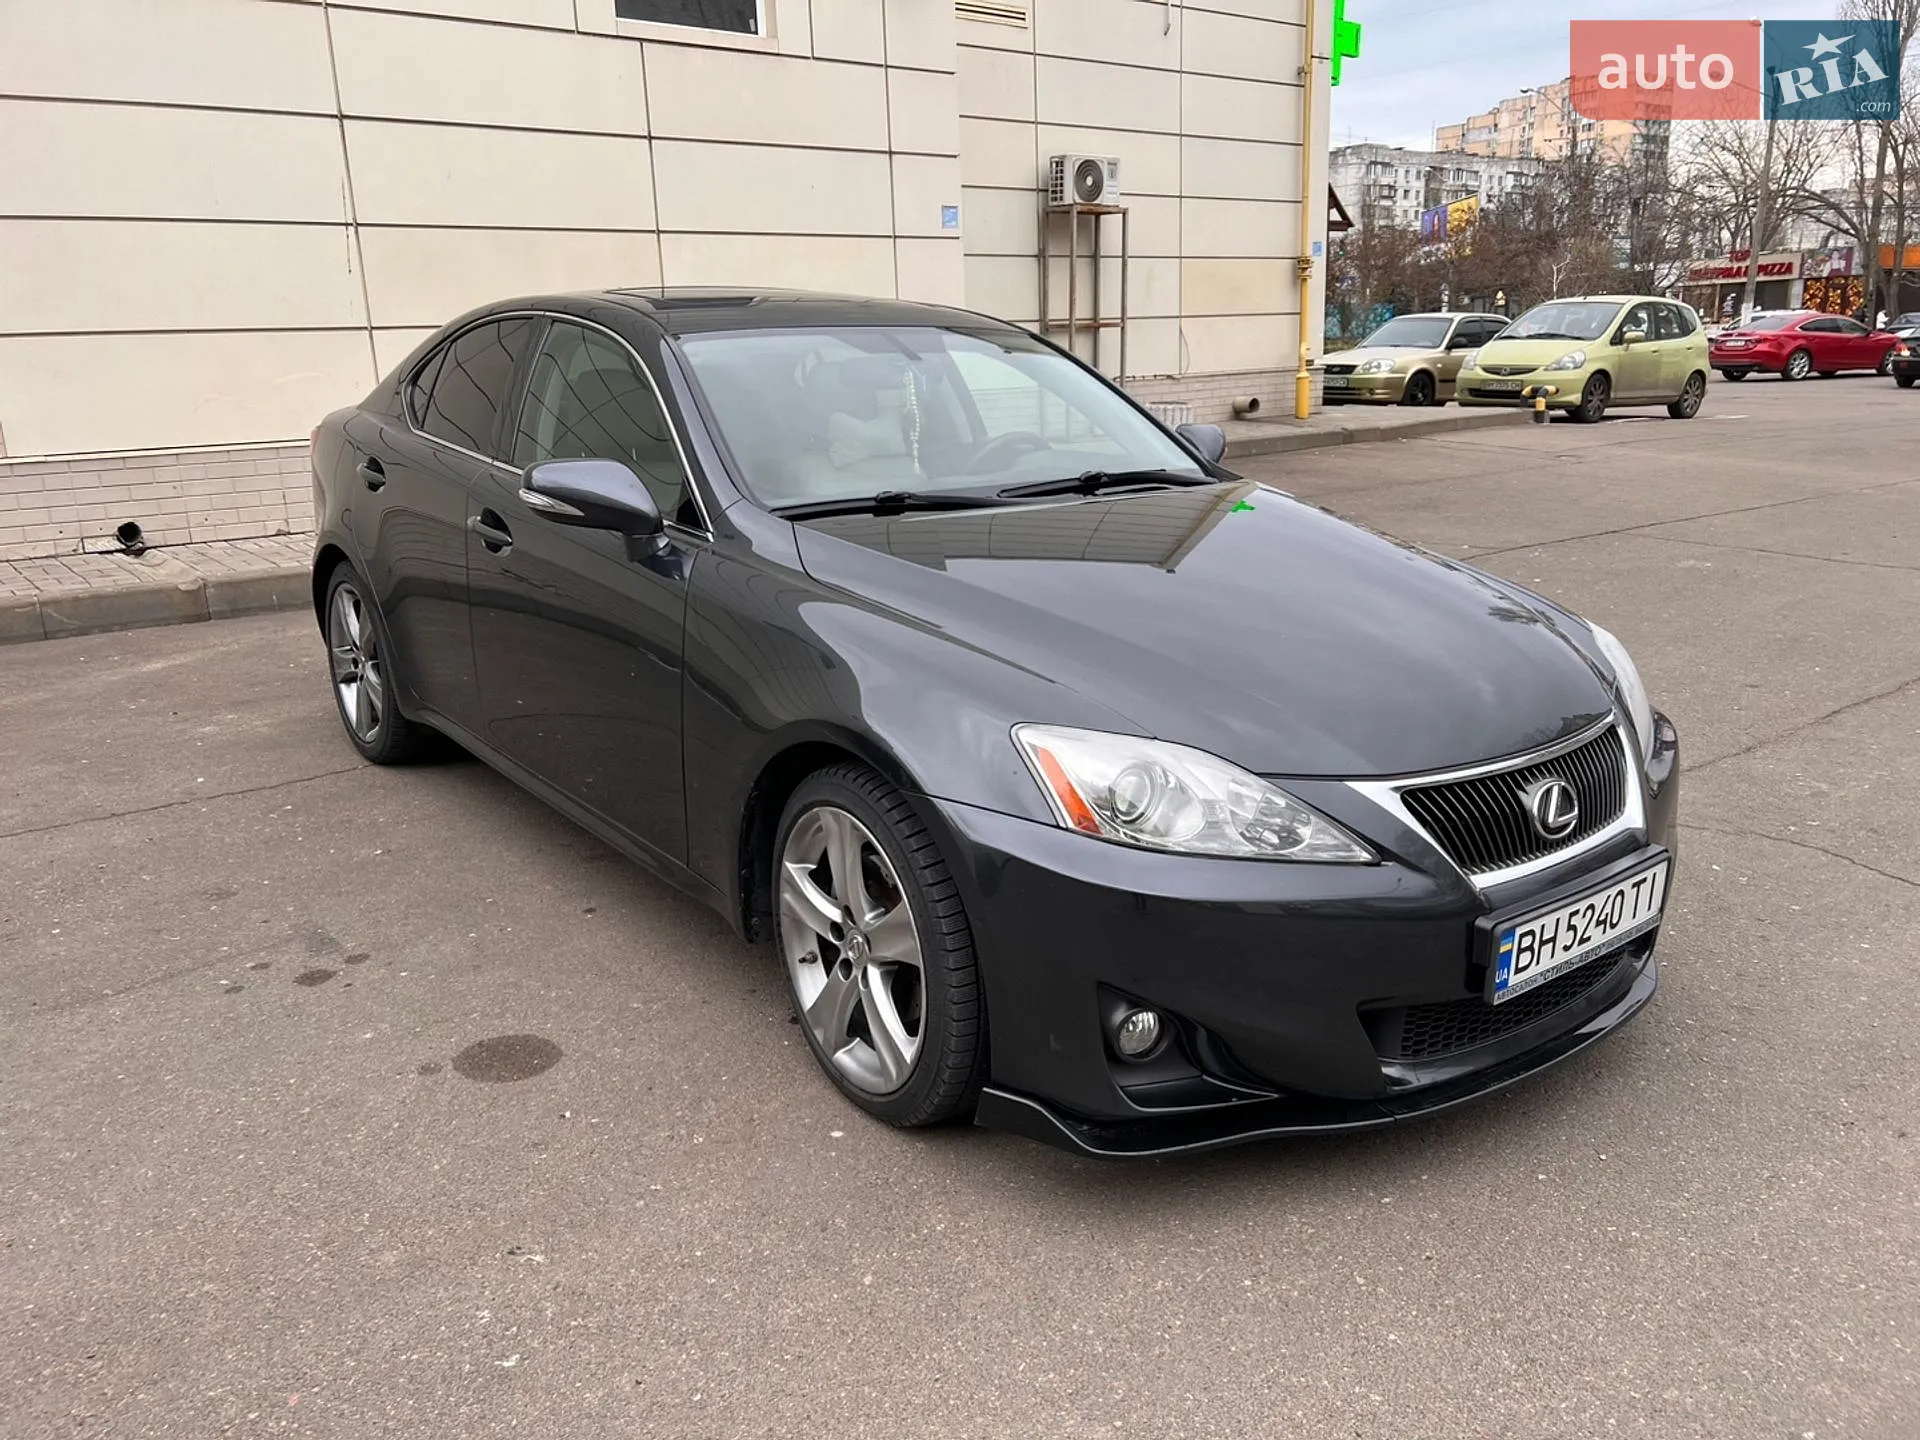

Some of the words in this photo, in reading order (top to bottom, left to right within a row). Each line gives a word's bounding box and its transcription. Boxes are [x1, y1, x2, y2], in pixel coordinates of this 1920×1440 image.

[1757, 261, 1794, 277] PIZZA
[1513, 917, 1561, 976] BH
[1562, 888, 1625, 953] 5240
[1631, 872, 1657, 920] TI
[1495, 969, 1509, 984] UA
